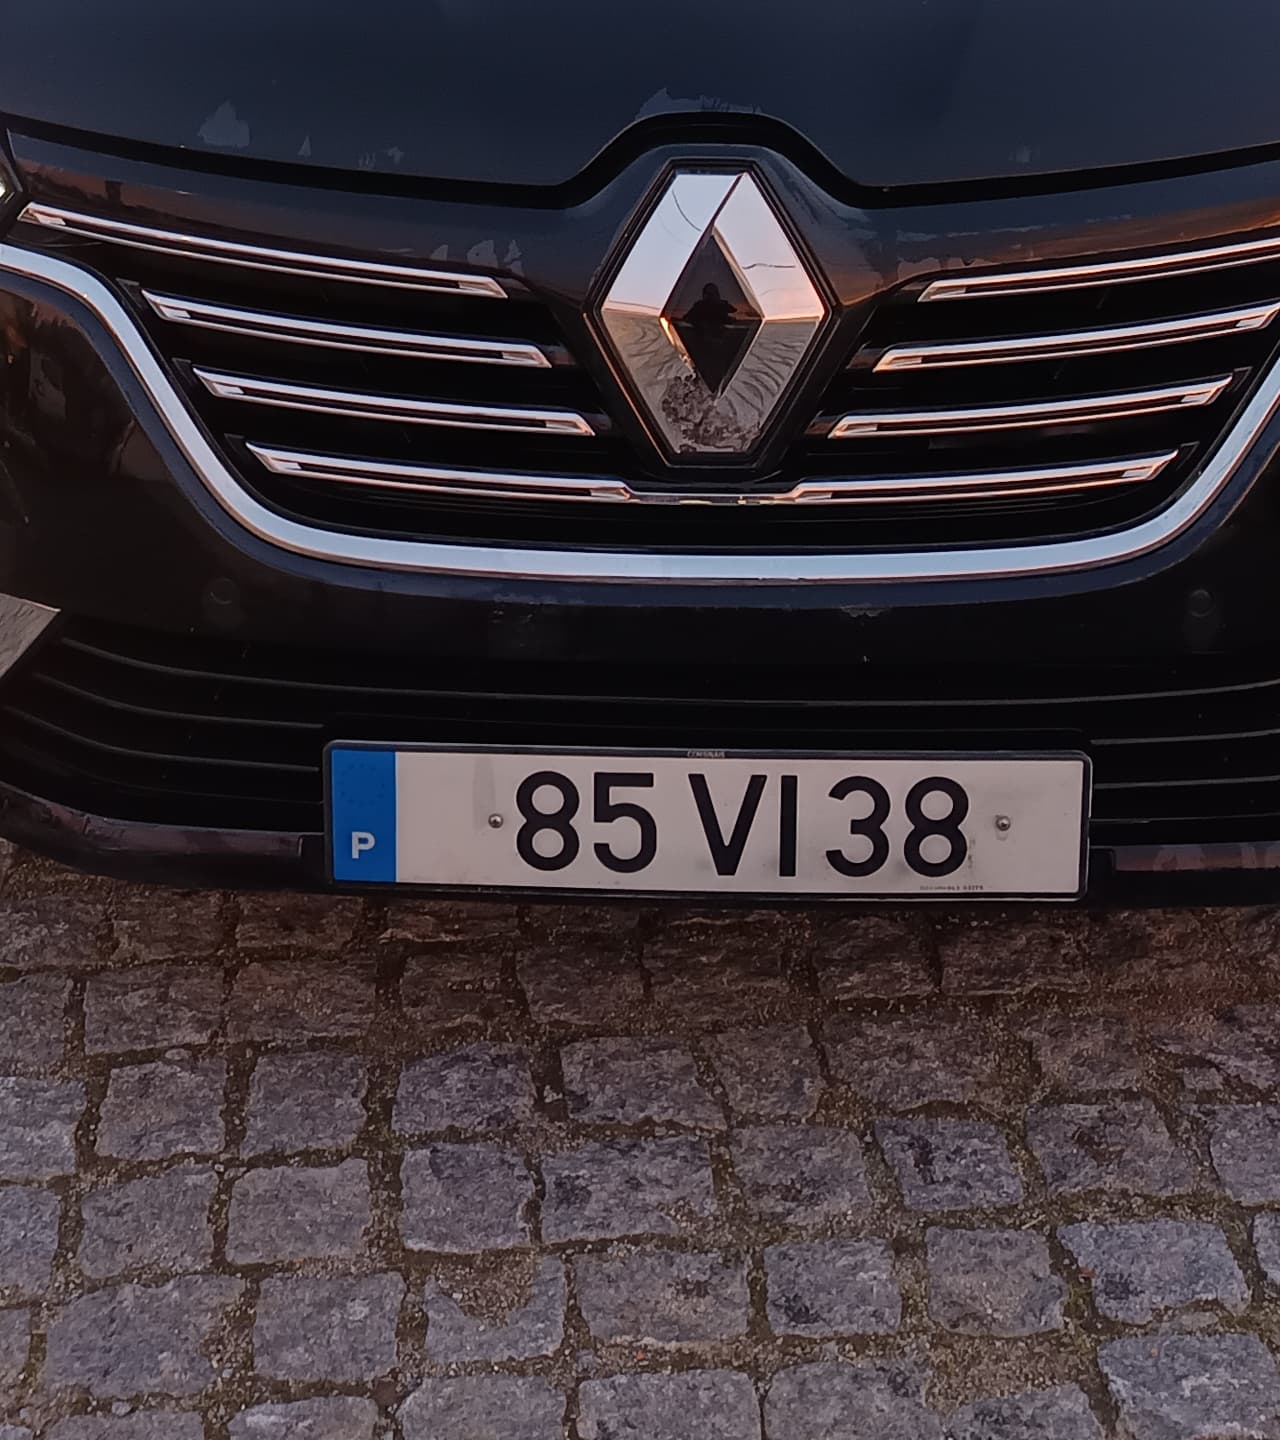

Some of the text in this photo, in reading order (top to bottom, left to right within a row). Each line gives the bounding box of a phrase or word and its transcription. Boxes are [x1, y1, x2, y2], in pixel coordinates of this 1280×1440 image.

[351, 831, 376, 859] P
[516, 770, 657, 874] 85
[825, 775, 969, 878] 38
